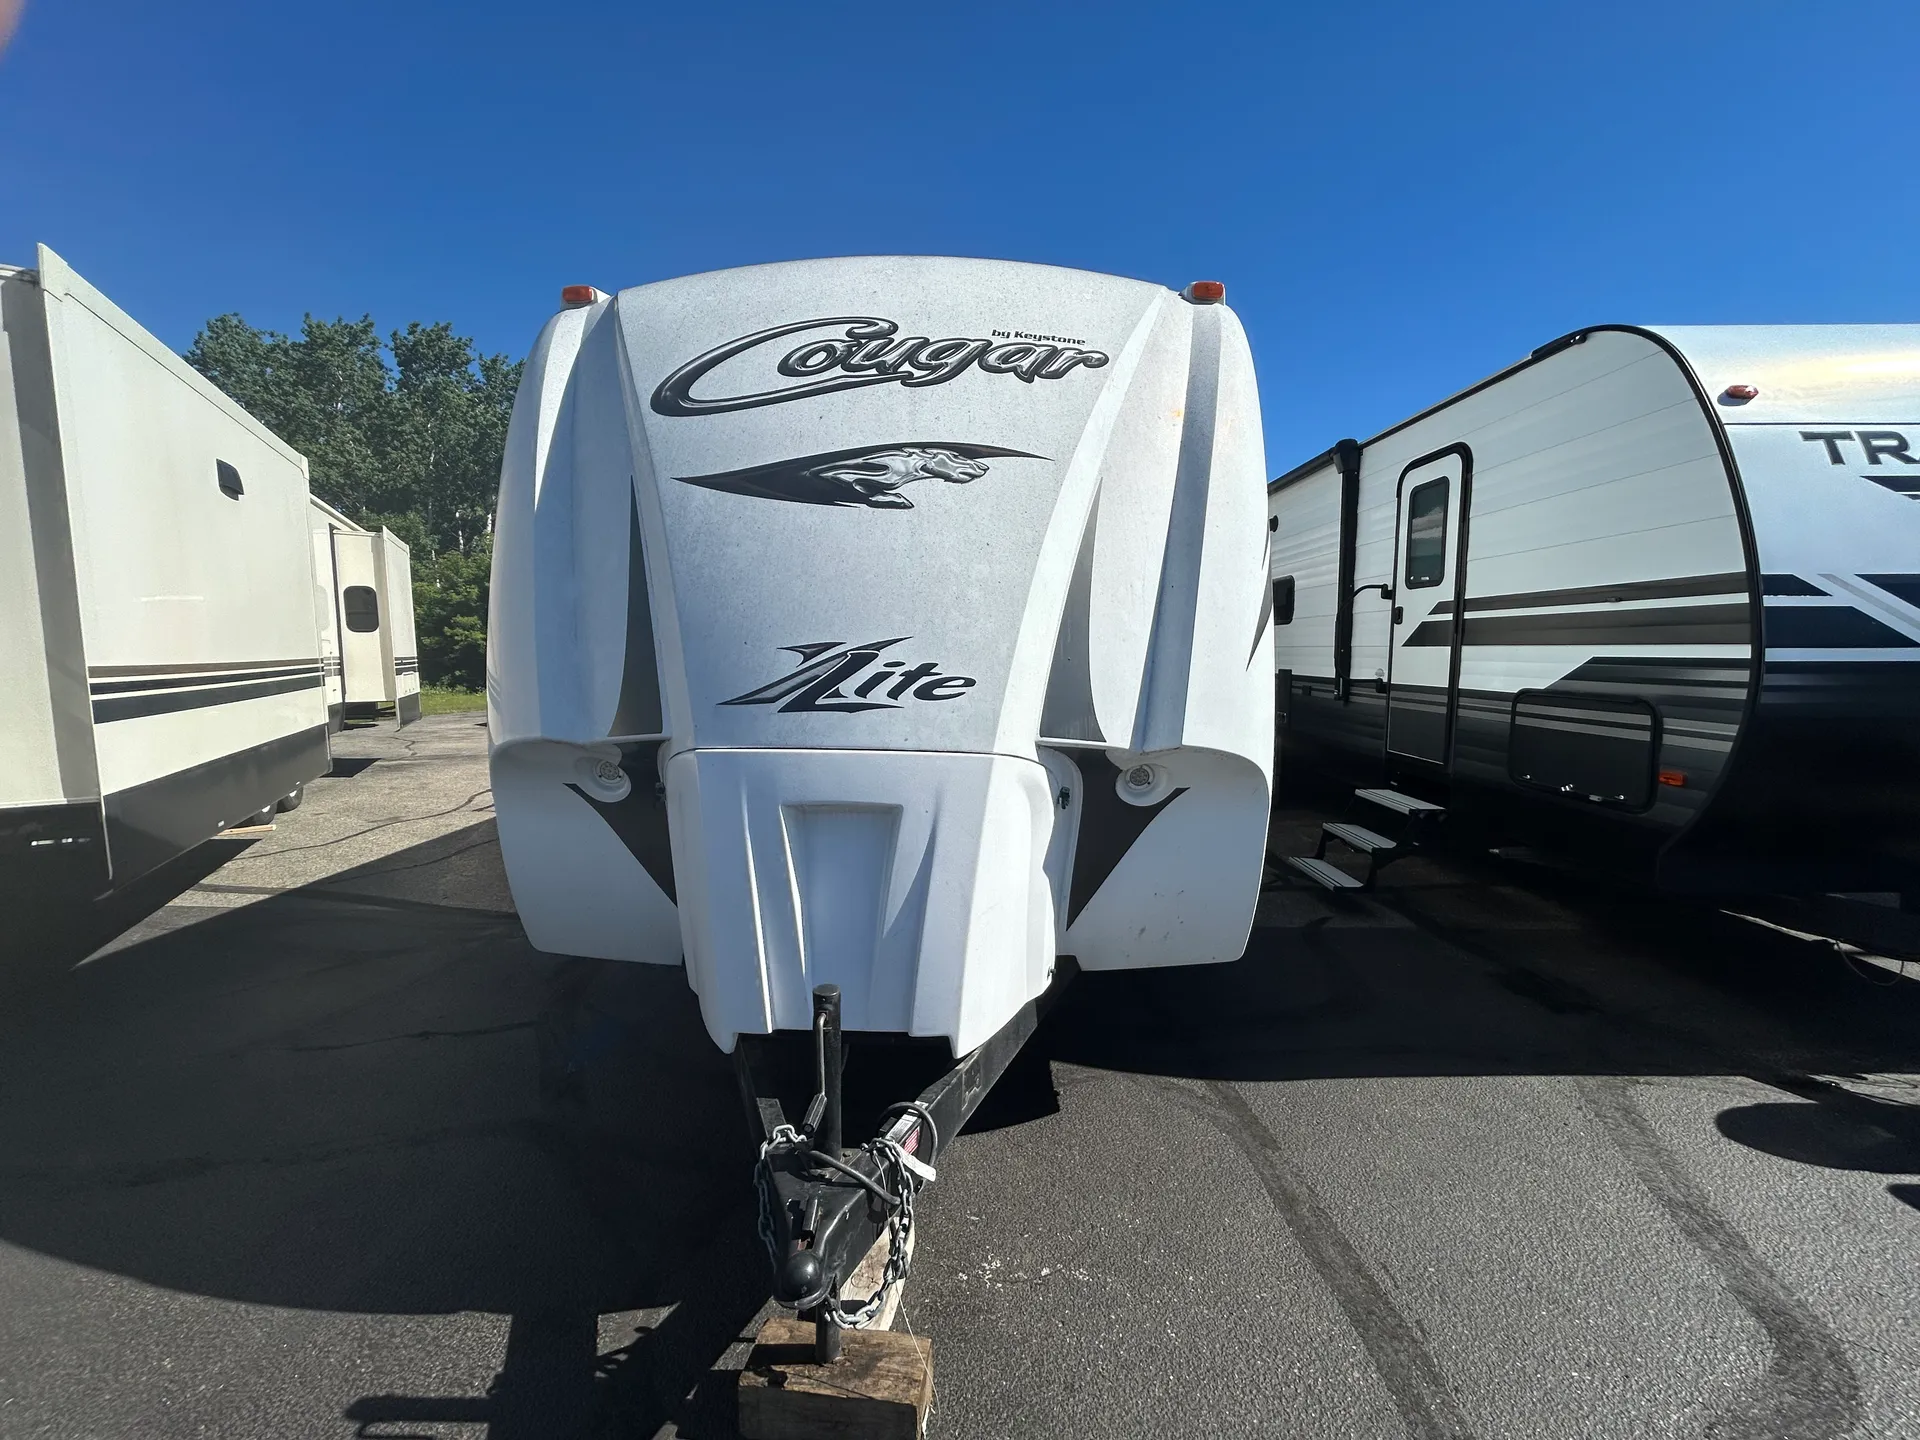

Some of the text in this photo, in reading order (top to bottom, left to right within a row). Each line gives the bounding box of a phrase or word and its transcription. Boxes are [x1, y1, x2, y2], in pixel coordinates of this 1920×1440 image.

[991, 329, 1086, 345] by Keystone
[650, 316, 1109, 417] Cougar
[1798, 430, 1920, 465] TR
